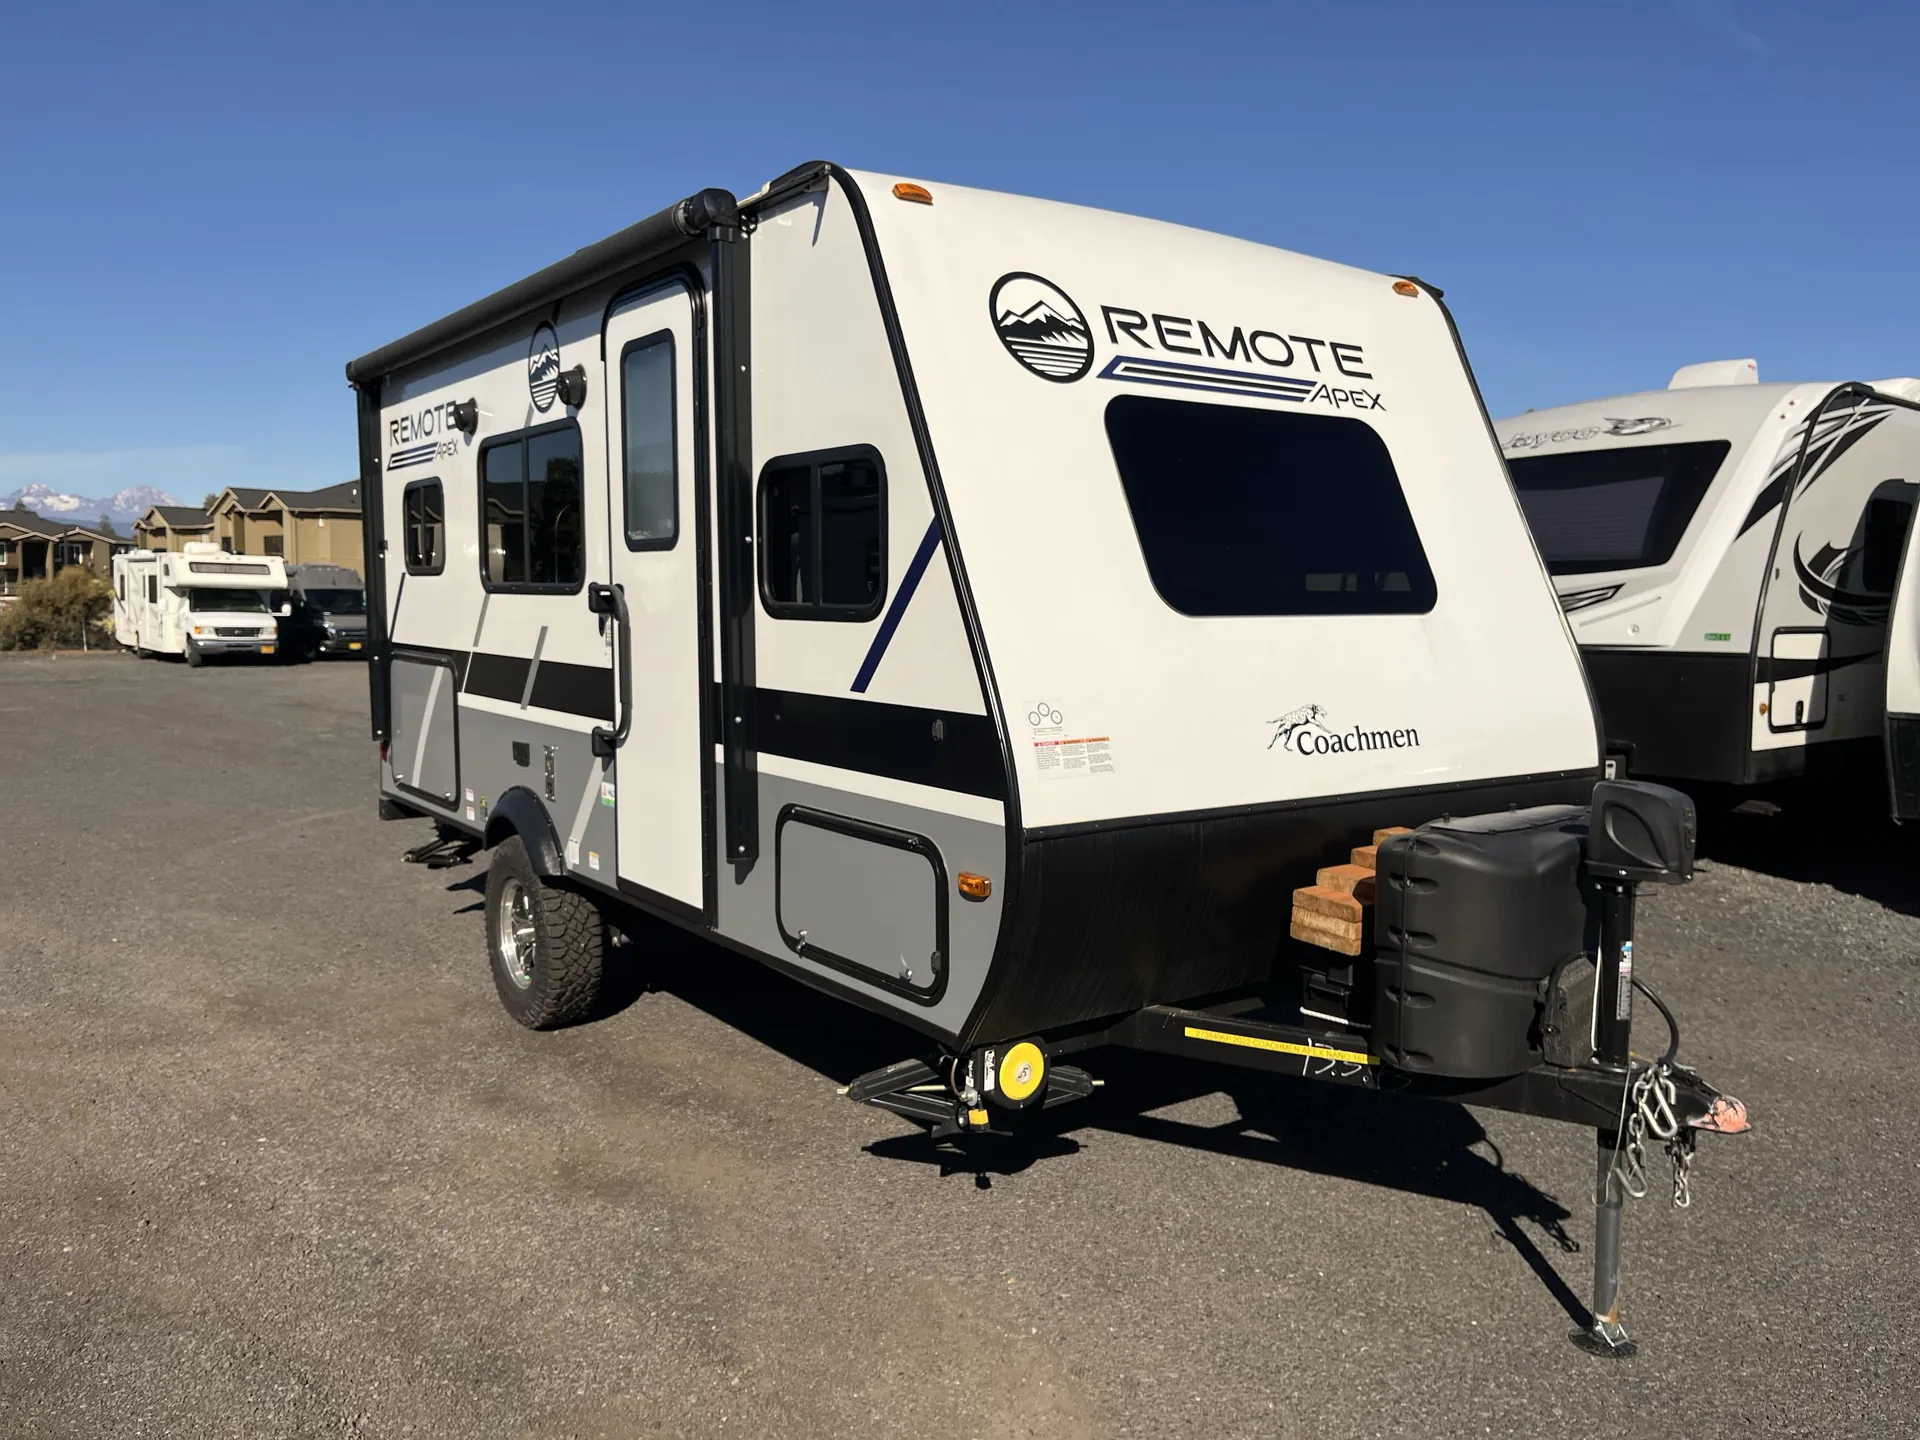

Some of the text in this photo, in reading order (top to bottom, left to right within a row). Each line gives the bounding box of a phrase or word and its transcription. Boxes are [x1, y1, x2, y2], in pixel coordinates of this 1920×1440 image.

[1100, 304, 1374, 380] REMOTE
[1309, 383, 1386, 412] APEX
[390, 400, 458, 447] REMOTE
[435, 438, 459, 461] APEX
[1296, 725, 1421, 756] Coachmen
[1252, 1039, 1300, 1053] COACHMEN
